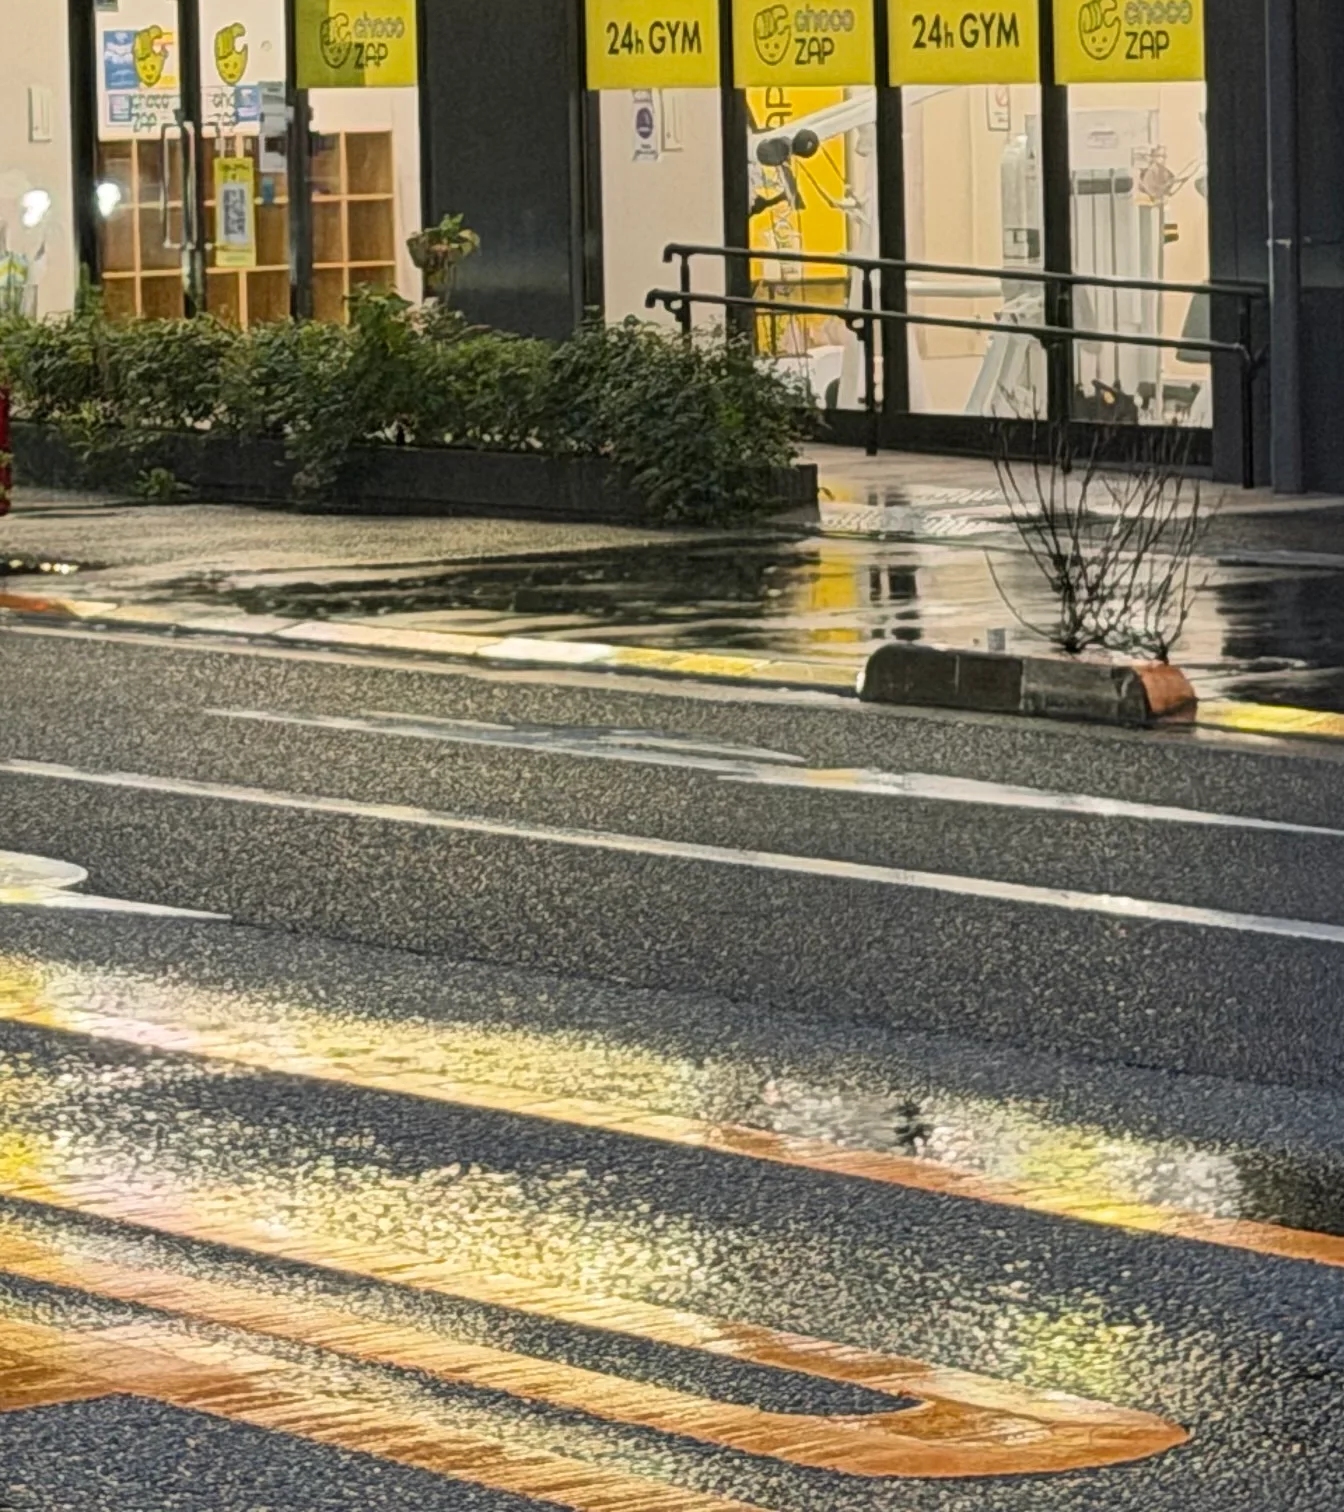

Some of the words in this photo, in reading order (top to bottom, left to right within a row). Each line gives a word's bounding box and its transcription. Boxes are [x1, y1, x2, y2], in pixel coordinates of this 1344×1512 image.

[353, 11, 405, 39] choco
[795, 4, 855, 33] choco
[912, 14, 954, 49] 24h
[959, 12, 1020, 48] GYM
[606, 22, 644, 55] 24h
[649, 20, 702, 54] GYM
[795, 38, 835, 66] ZAP
[1125, 30, 1170, 60] ZAP
[354, 42, 388, 69] ZAP
